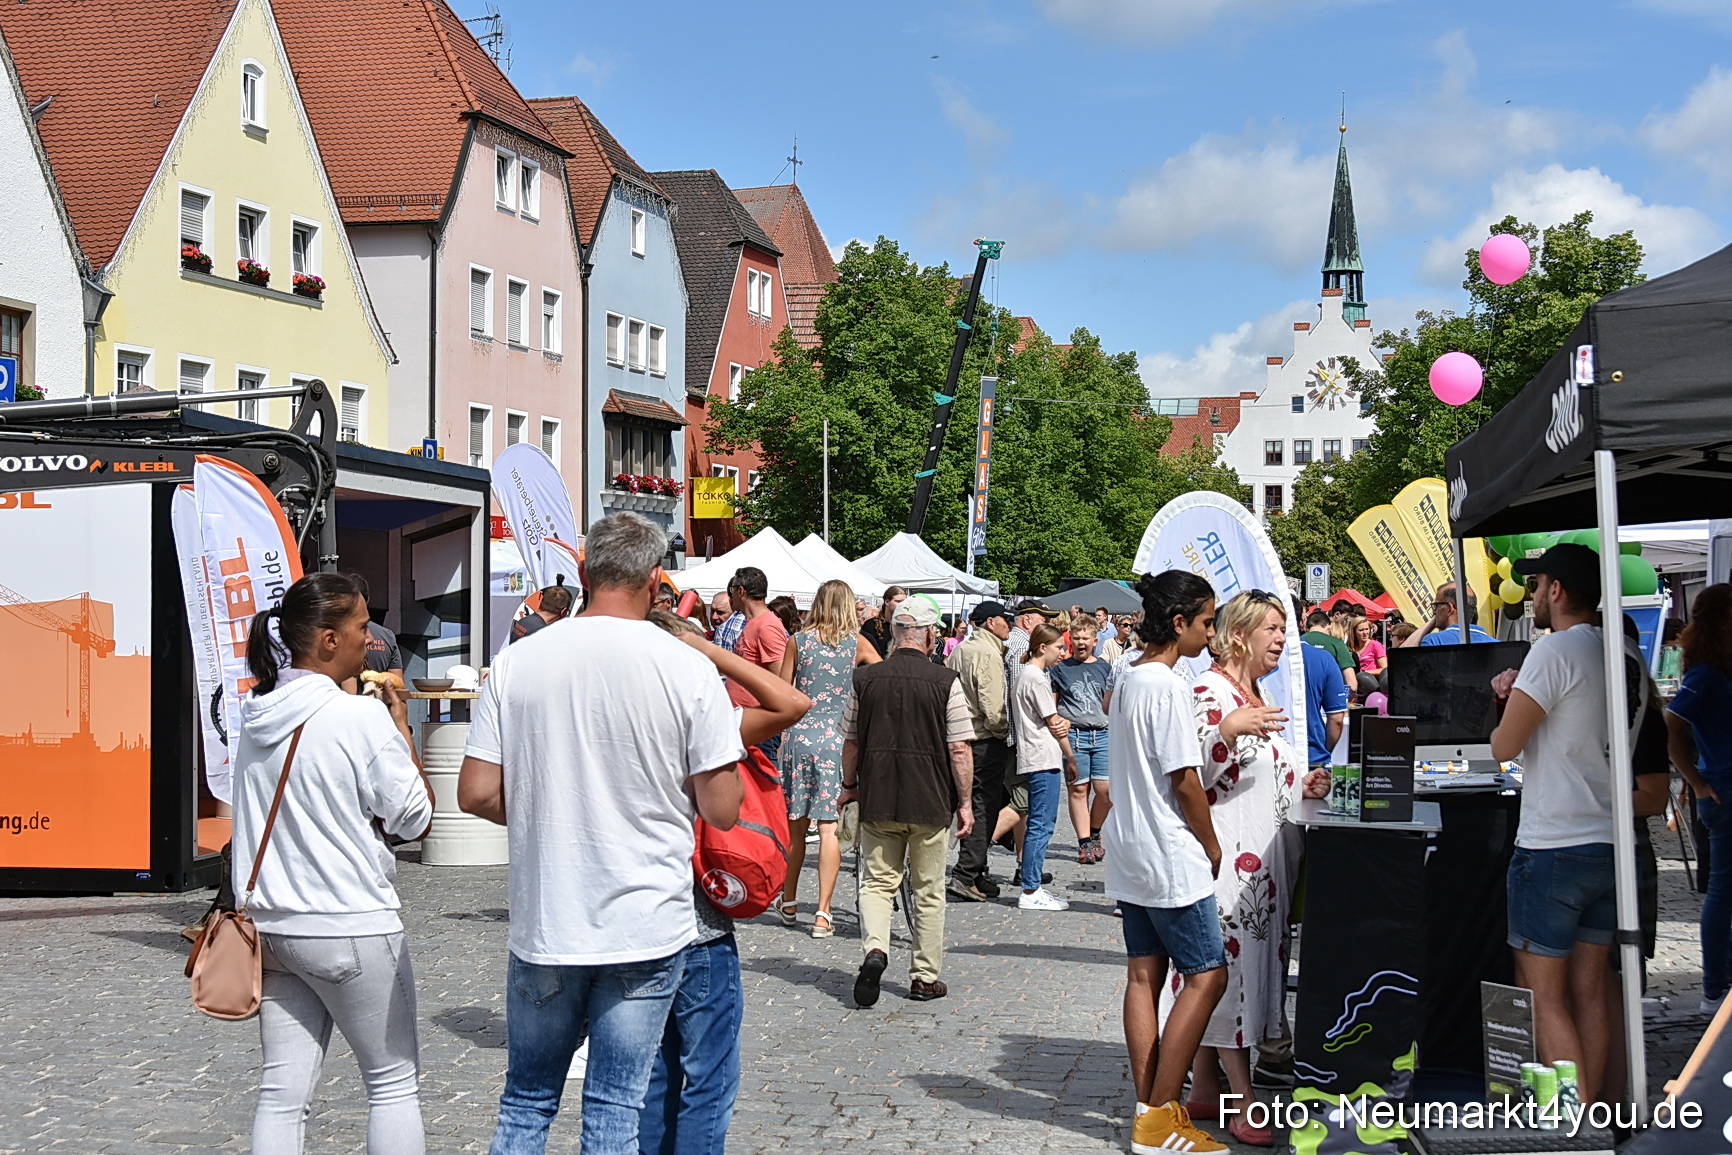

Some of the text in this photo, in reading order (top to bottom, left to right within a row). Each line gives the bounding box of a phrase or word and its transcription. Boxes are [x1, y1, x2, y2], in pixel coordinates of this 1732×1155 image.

[0, 455, 181, 472] OLVO KLEBL
[976, 399, 991, 521] GLAS
